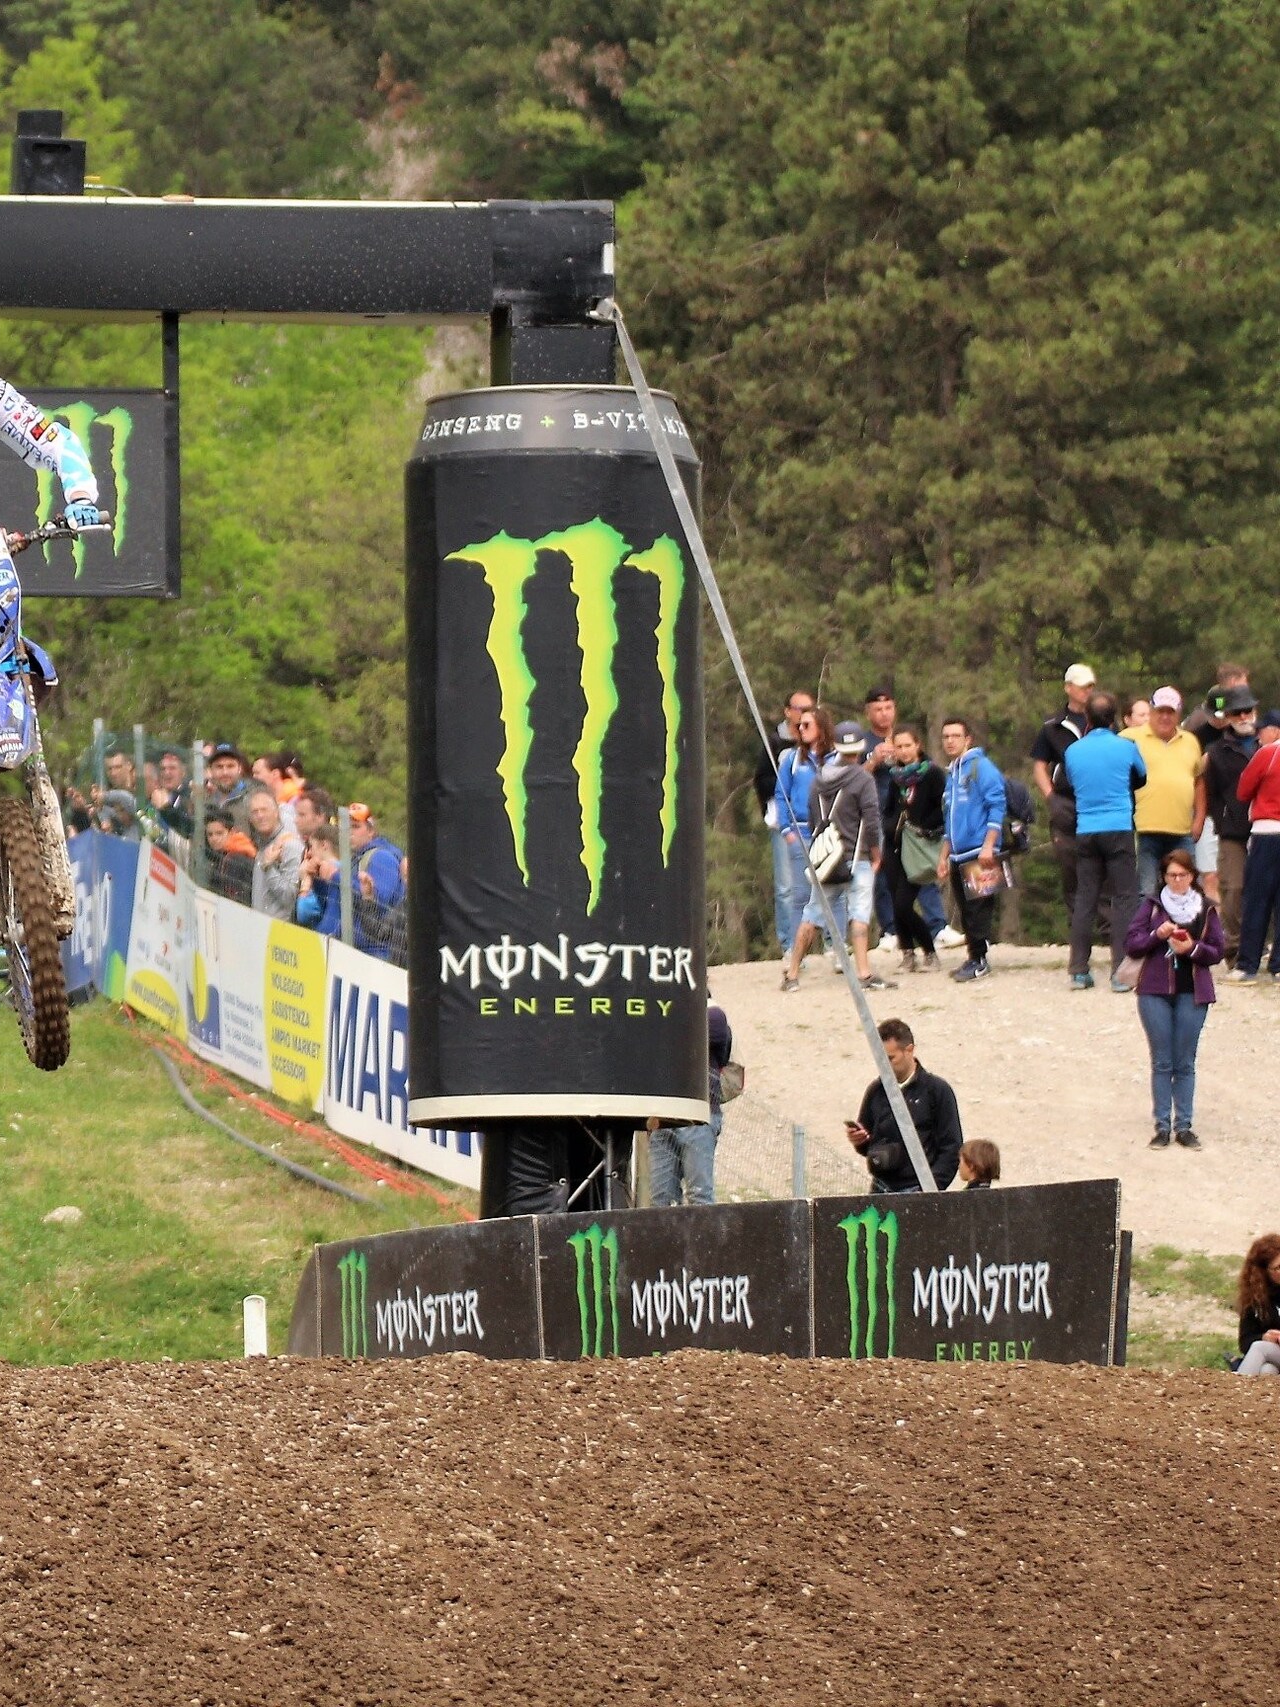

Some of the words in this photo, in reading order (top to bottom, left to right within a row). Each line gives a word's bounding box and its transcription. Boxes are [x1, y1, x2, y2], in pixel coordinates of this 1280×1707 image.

[422, 413, 522, 441] GINSENG
[438, 933, 697, 991] MONSTER
[479, 997, 673, 1017] ENERGY
[375, 1284, 485, 1353] MONSTER
[631, 1266, 754, 1339] MONSTER
[912, 1252, 1054, 1329] MONSTER
[936, 1340, 1033, 1362] ENERGY
